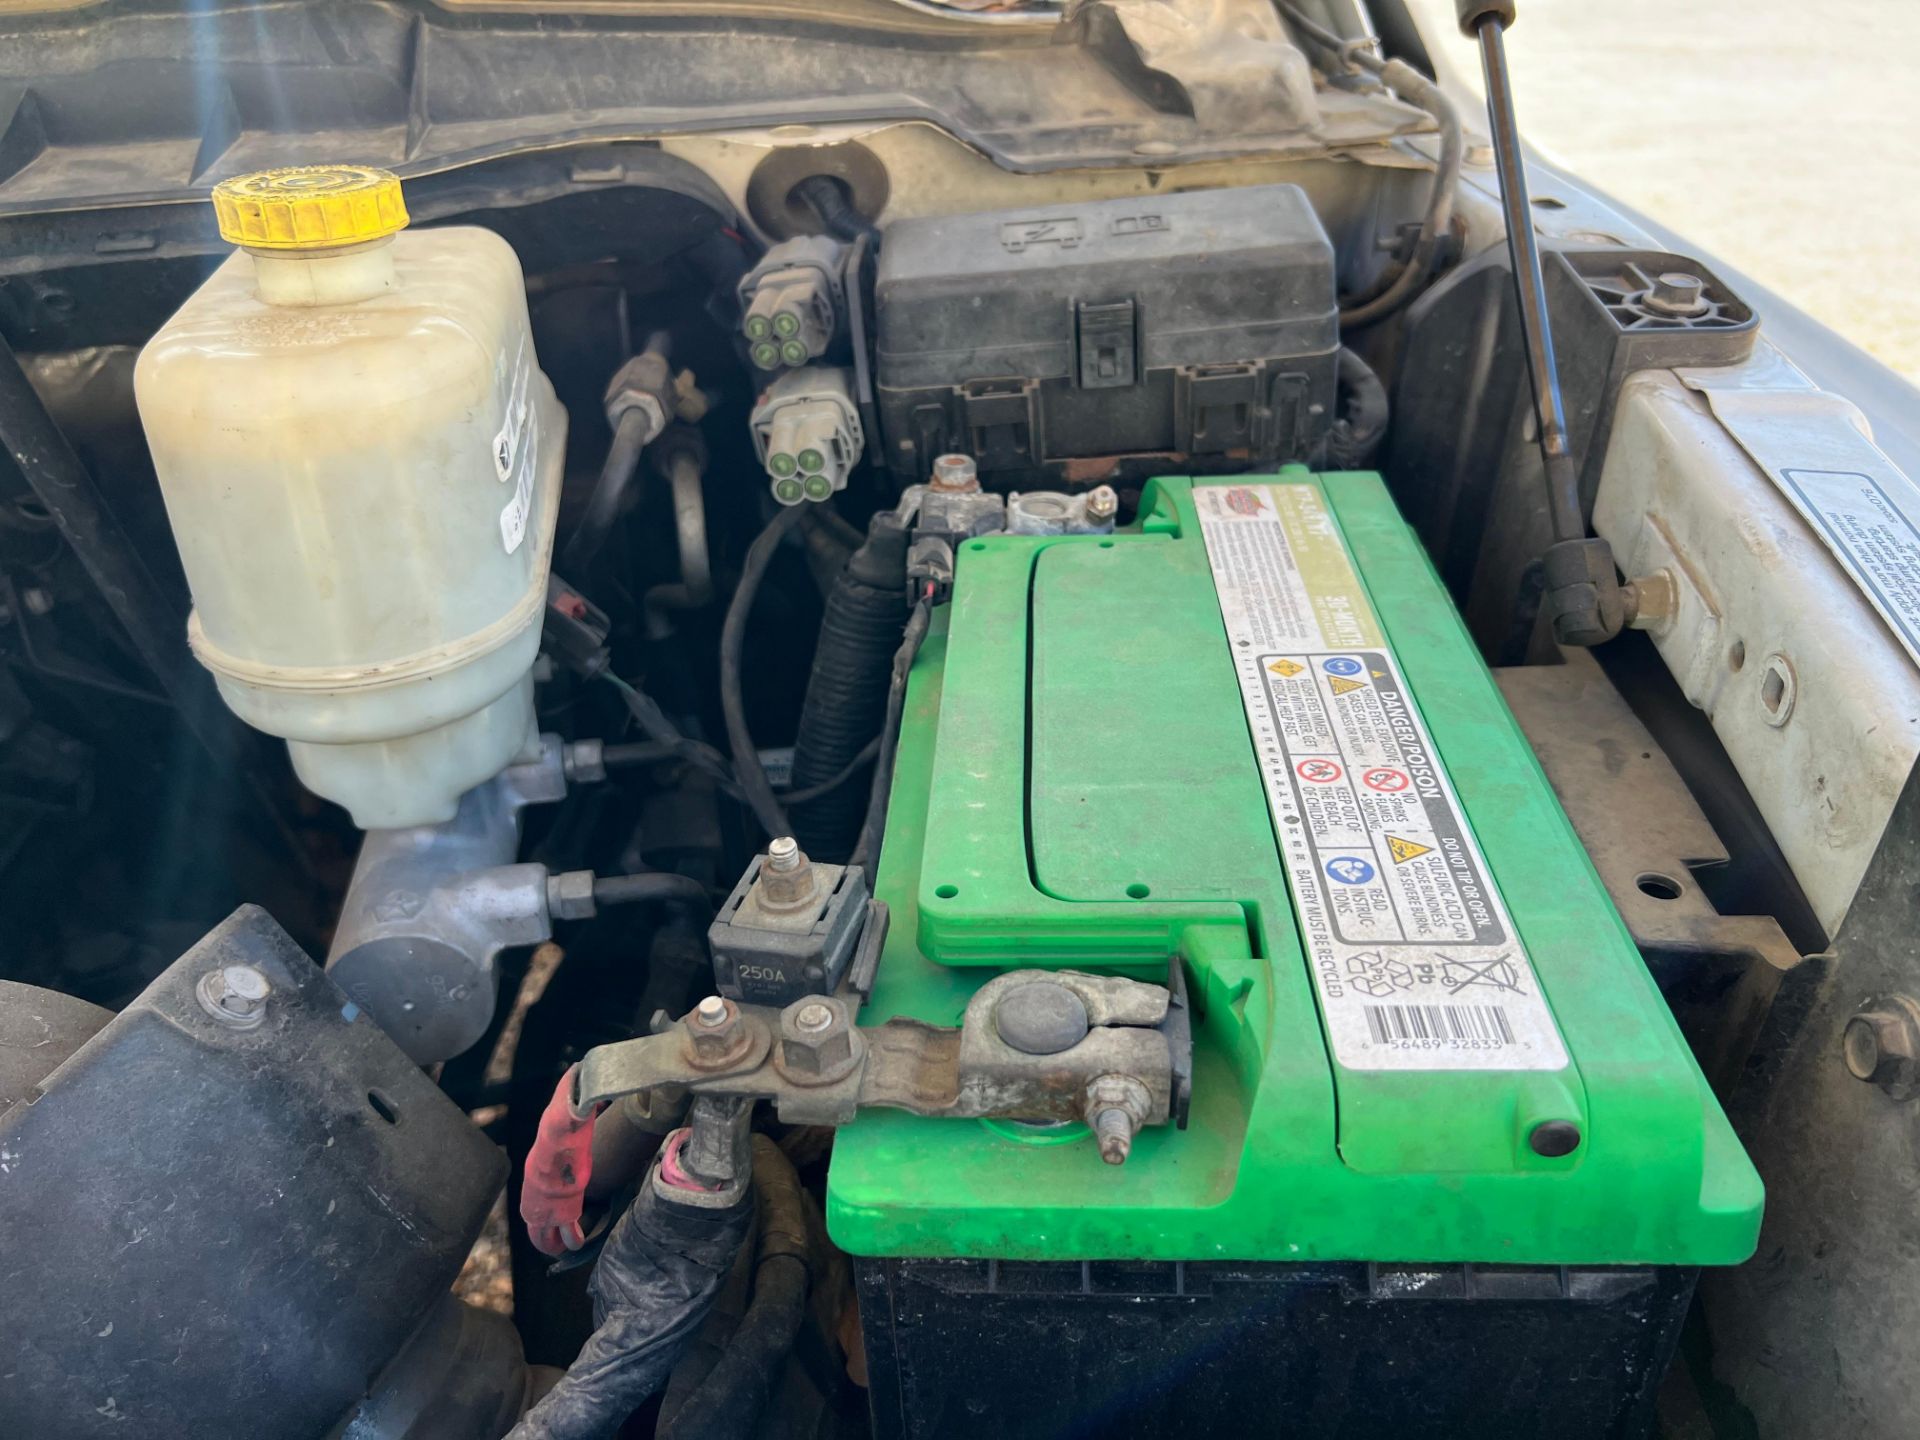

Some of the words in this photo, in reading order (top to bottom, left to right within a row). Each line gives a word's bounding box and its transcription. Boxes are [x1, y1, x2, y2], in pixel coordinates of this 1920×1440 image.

[1843, 513, 1868, 538] during
[1877, 524, 1906, 554] system
[1854, 542, 1874, 564] than
[1866, 538, 1893, 571] system
[1871, 566, 1893, 593] more
[1896, 562, 1917, 587] jump
[1890, 590, 1915, 618] apply
[1324, 595, 1366, 646] 30-MONTH
[1270, 679, 1288, 704] MEDICAL
[1298, 678, 1315, 696] FLUSH
[1278, 705, 1293, 720] HELP
[1304, 698, 1320, 711] EYES
[1347, 694, 1364, 712] GASES
[1289, 696, 1305, 710] WITH
[1301, 735, 1317, 747] GET
[1354, 713, 1369, 724] CAN
[1360, 689, 1379, 708] SHIELD
[1375, 728, 1400, 762] EXPLOSIVE
[1358, 726, 1376, 743] CAUSE
[1379, 691, 1440, 797] DANGER/POISON
[1301, 786, 1317, 796] OF
[1317, 786, 1334, 799] THE
[1334, 786, 1352, 804] KEEP
[1401, 792, 1417, 803] NO
[1305, 797, 1329, 837] CHILDREN.
[1322, 801, 1342, 825] REACH
[1340, 806, 1358, 820] OUT
[1360, 798, 1382, 829] SMOKING
[1374, 798, 1394, 822] FLAMES
[1388, 798, 1408, 821] SPARKS
[1345, 822, 1362, 832] OF
[1441, 837, 1459, 848] DO
[1447, 851, 1467, 868] NOT
[1395, 867, 1411, 878] OR
[1410, 862, 1430, 883] CAUSE
[1425, 856, 1454, 896] SULFURIC
[1455, 870, 1473, 883] TIP
[1296, 869, 1318, 903] BATTERY
[1399, 878, 1421, 906] SEVERE
[1460, 885, 1480, 898] OR
[1331, 888, 1353, 915] TIONS.
[1349, 888, 1375, 927] INSTRUC-
[1367, 888, 1388, 910] READ
[1419, 885, 1447, 927] BLINDNESS
[1442, 898, 1464, 919] ACID
[1305, 907, 1326, 932] MUST
[1410, 908, 1432, 936] BURNS.
[1467, 900, 1492, 927] OPEN.
[1312, 934, 1330, 945] BE
[1451, 922, 1471, 938] CAN
[739, 964, 786, 983] 250A
[1316, 948, 1344, 997] RECYCLED
[1370, 968, 1384, 980] Pb
[1413, 964, 1437, 984] Pb
[1391, 1040, 1441, 1050] 56489
